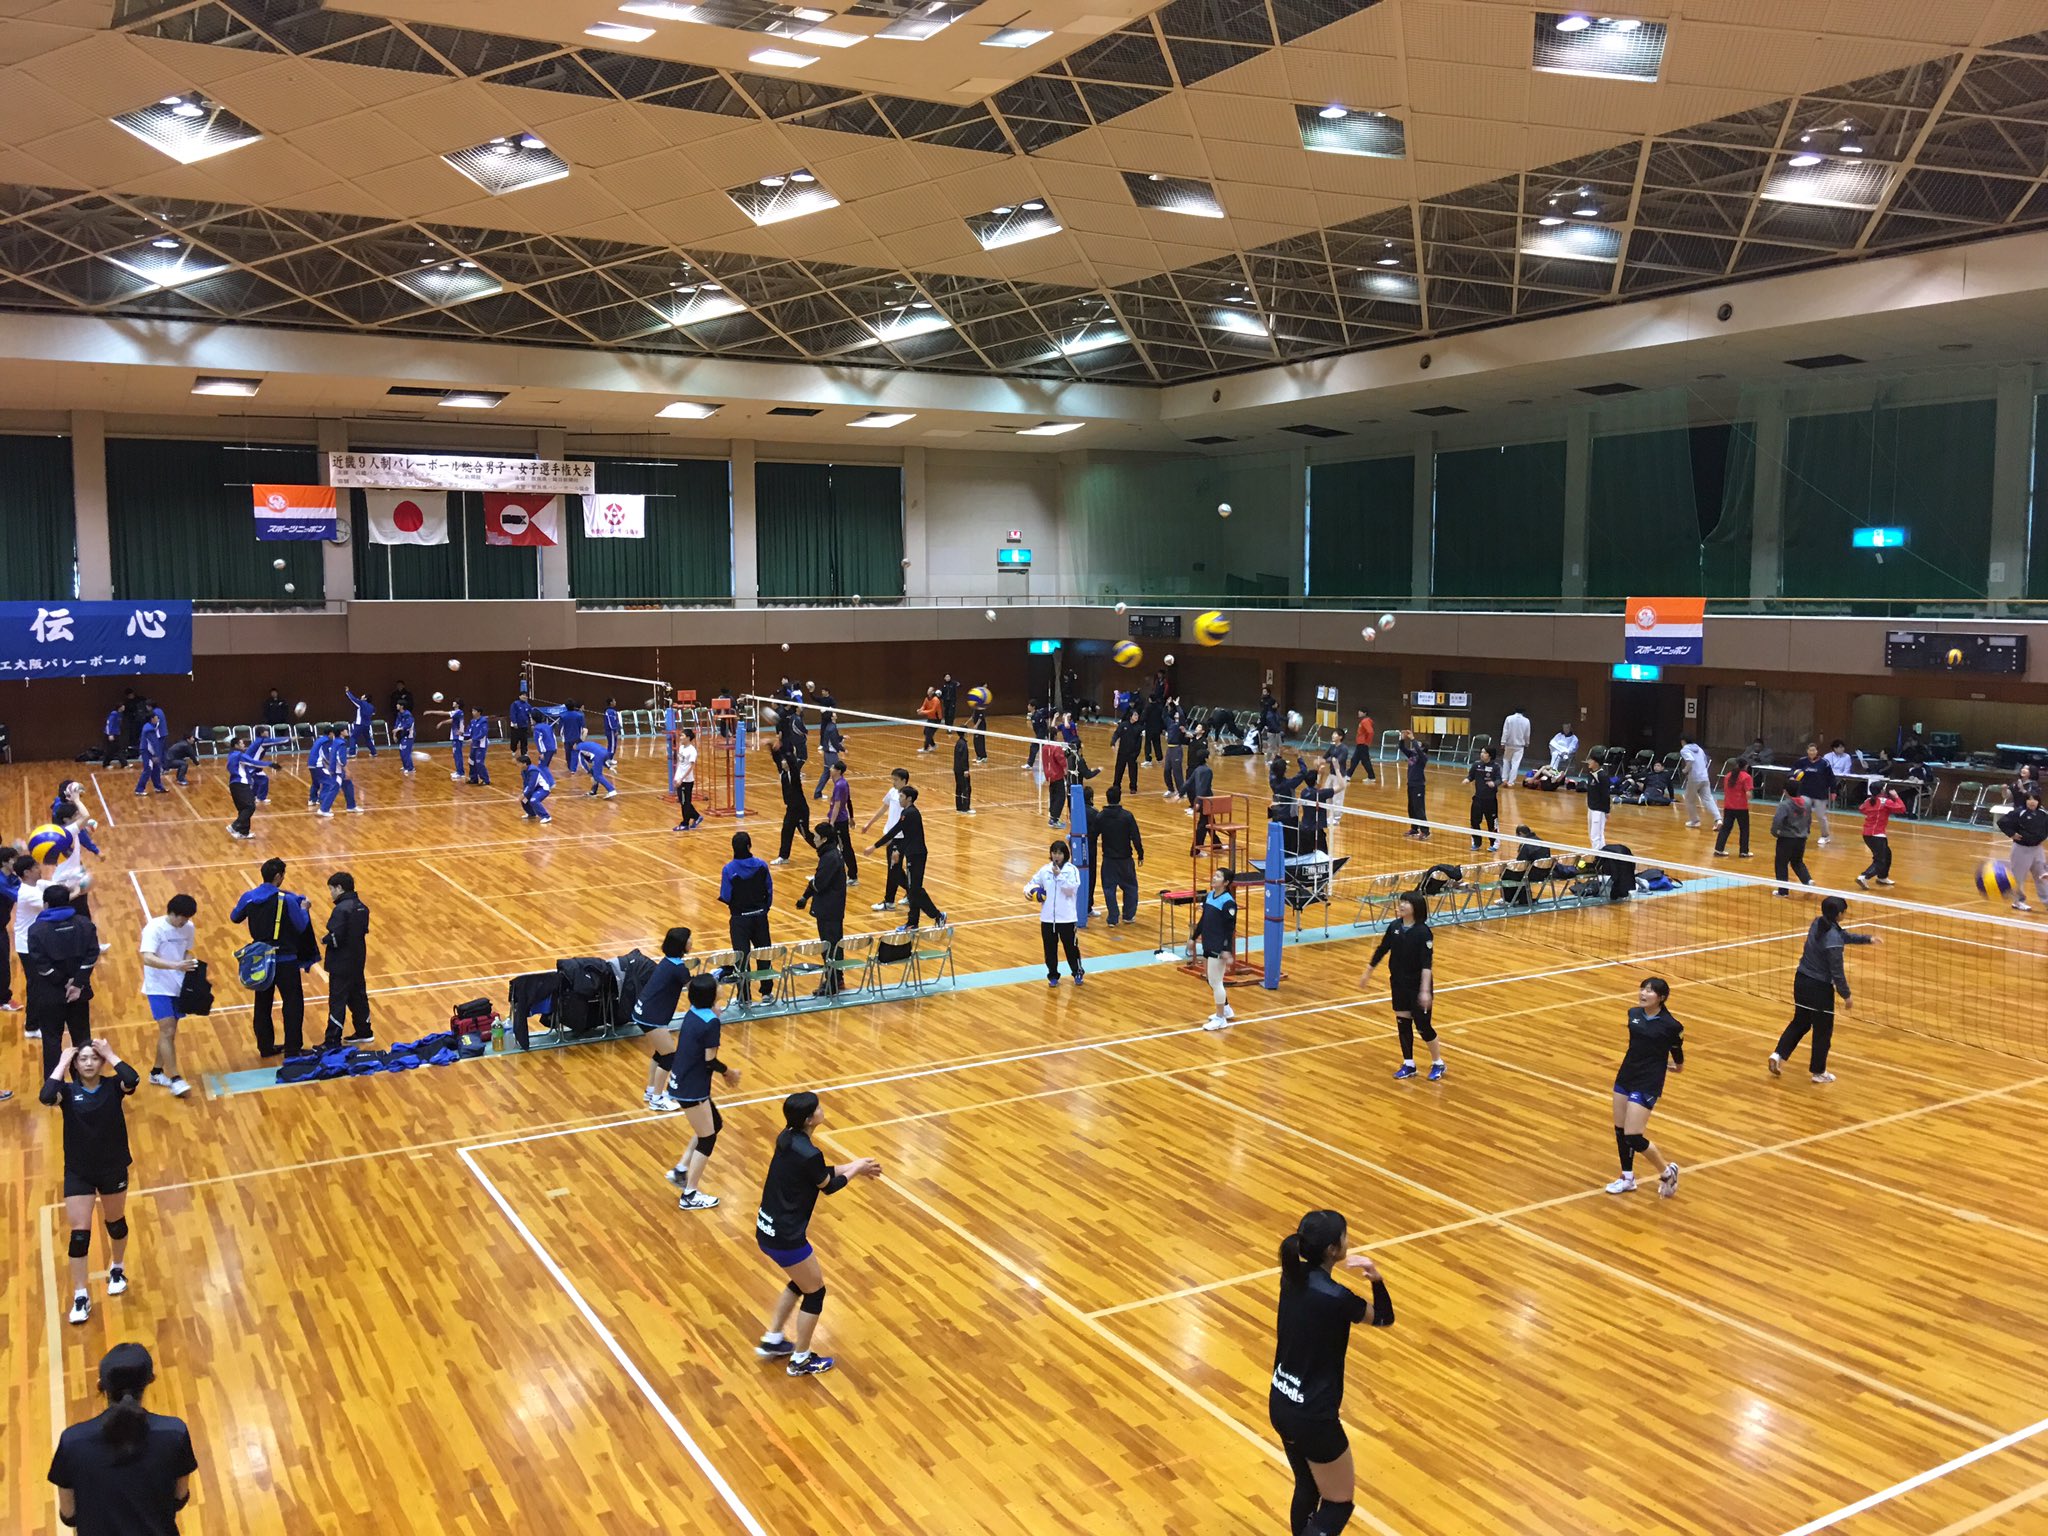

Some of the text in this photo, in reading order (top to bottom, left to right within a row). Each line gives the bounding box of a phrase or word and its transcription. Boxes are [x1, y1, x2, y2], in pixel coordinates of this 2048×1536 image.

[267, 524, 326, 533] スポーツニッポン
[1634, 645, 1692, 655] スポーツニッポン
[1687, 702, 1696, 714] B
